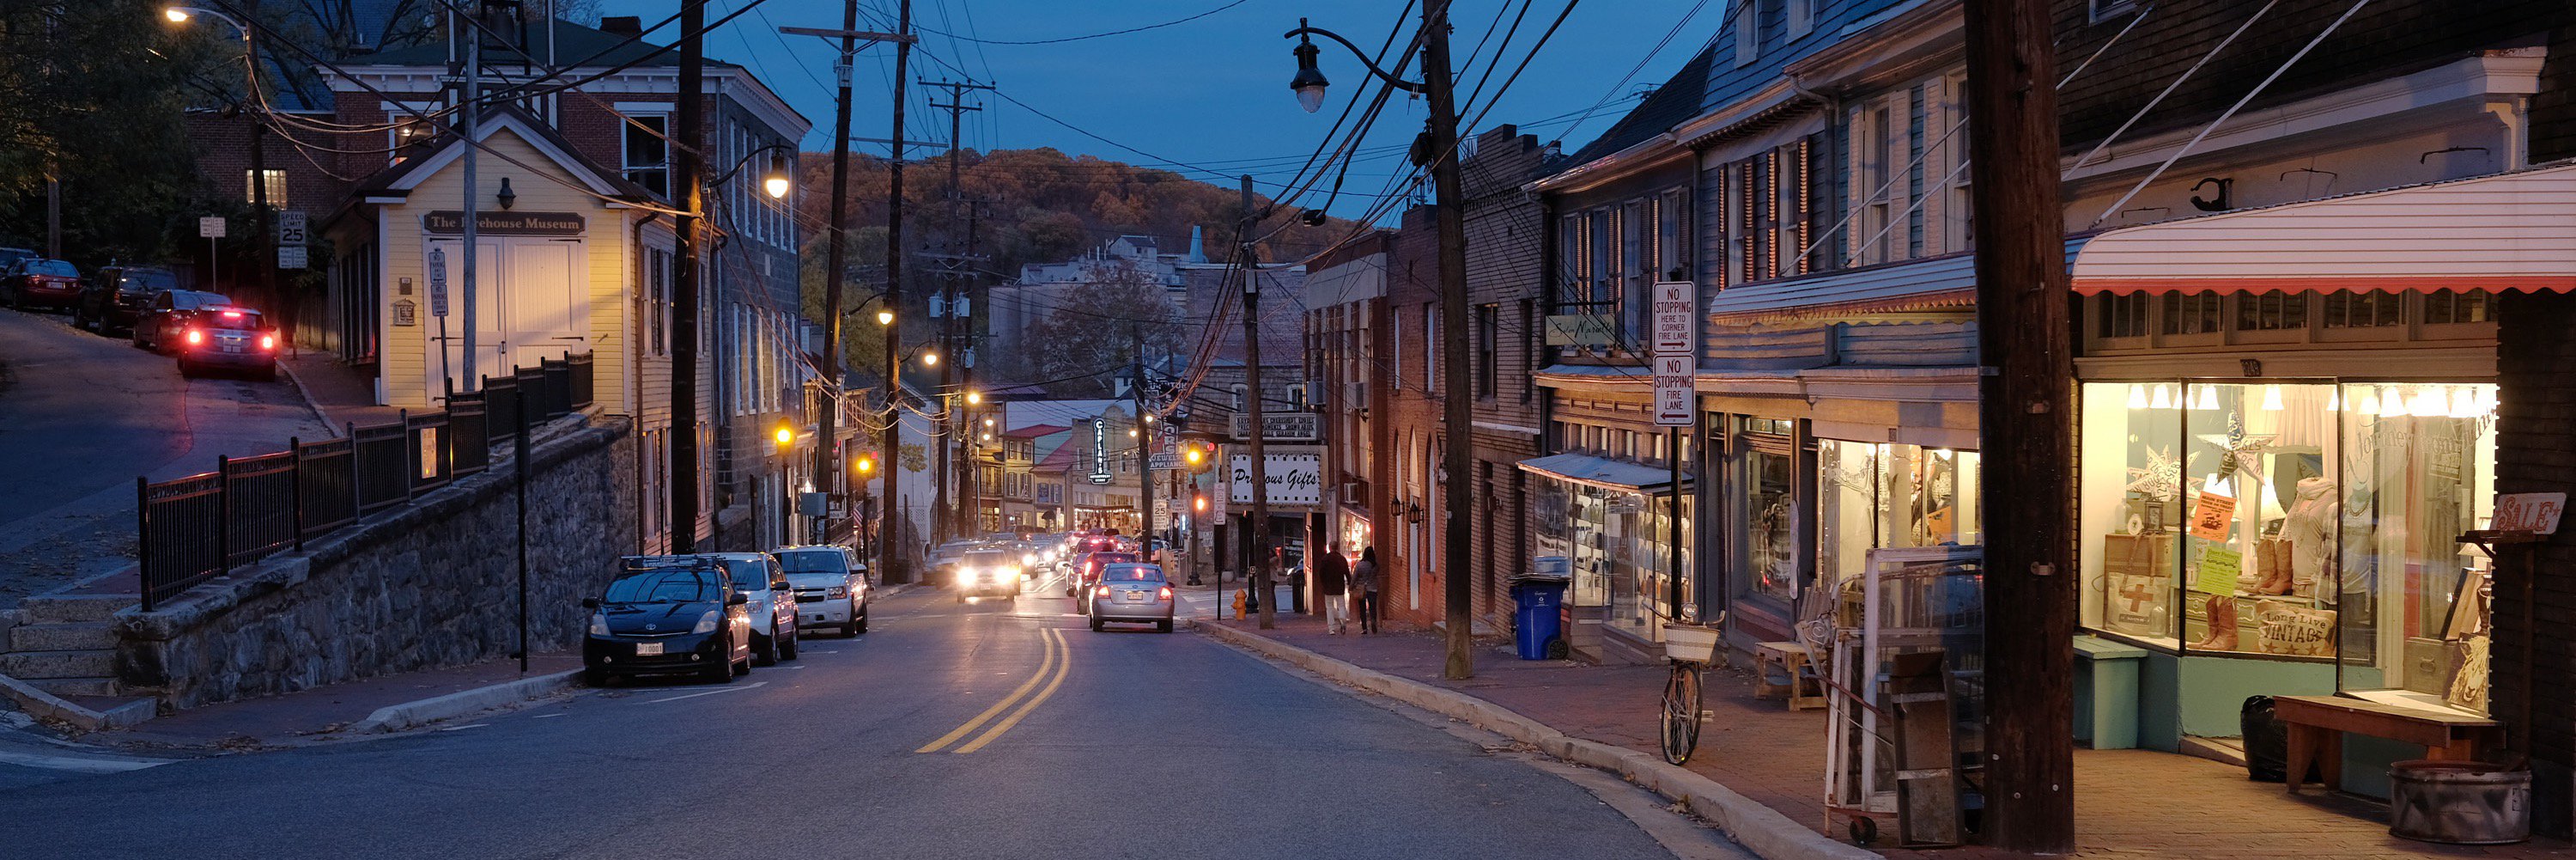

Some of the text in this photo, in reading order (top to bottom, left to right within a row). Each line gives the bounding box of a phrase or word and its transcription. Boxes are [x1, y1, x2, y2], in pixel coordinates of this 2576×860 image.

[431, 217, 580, 229] The ehouse Museum
[283, 229, 303, 241] 25
[1668, 289, 1680, 301] NO
[1656, 302, 1691, 314] STOPPING
[1667, 360, 1680, 373] NO
[1656, 375, 1692, 388] STOPPING
[1665, 401, 1684, 410] LANE
[1287, 468, 1317, 491] Gifts
[2496, 497, 2555, 532] SALE
[2266, 613, 2326, 630] Long Live
[2264, 624, 2324, 643] VINTAGE
